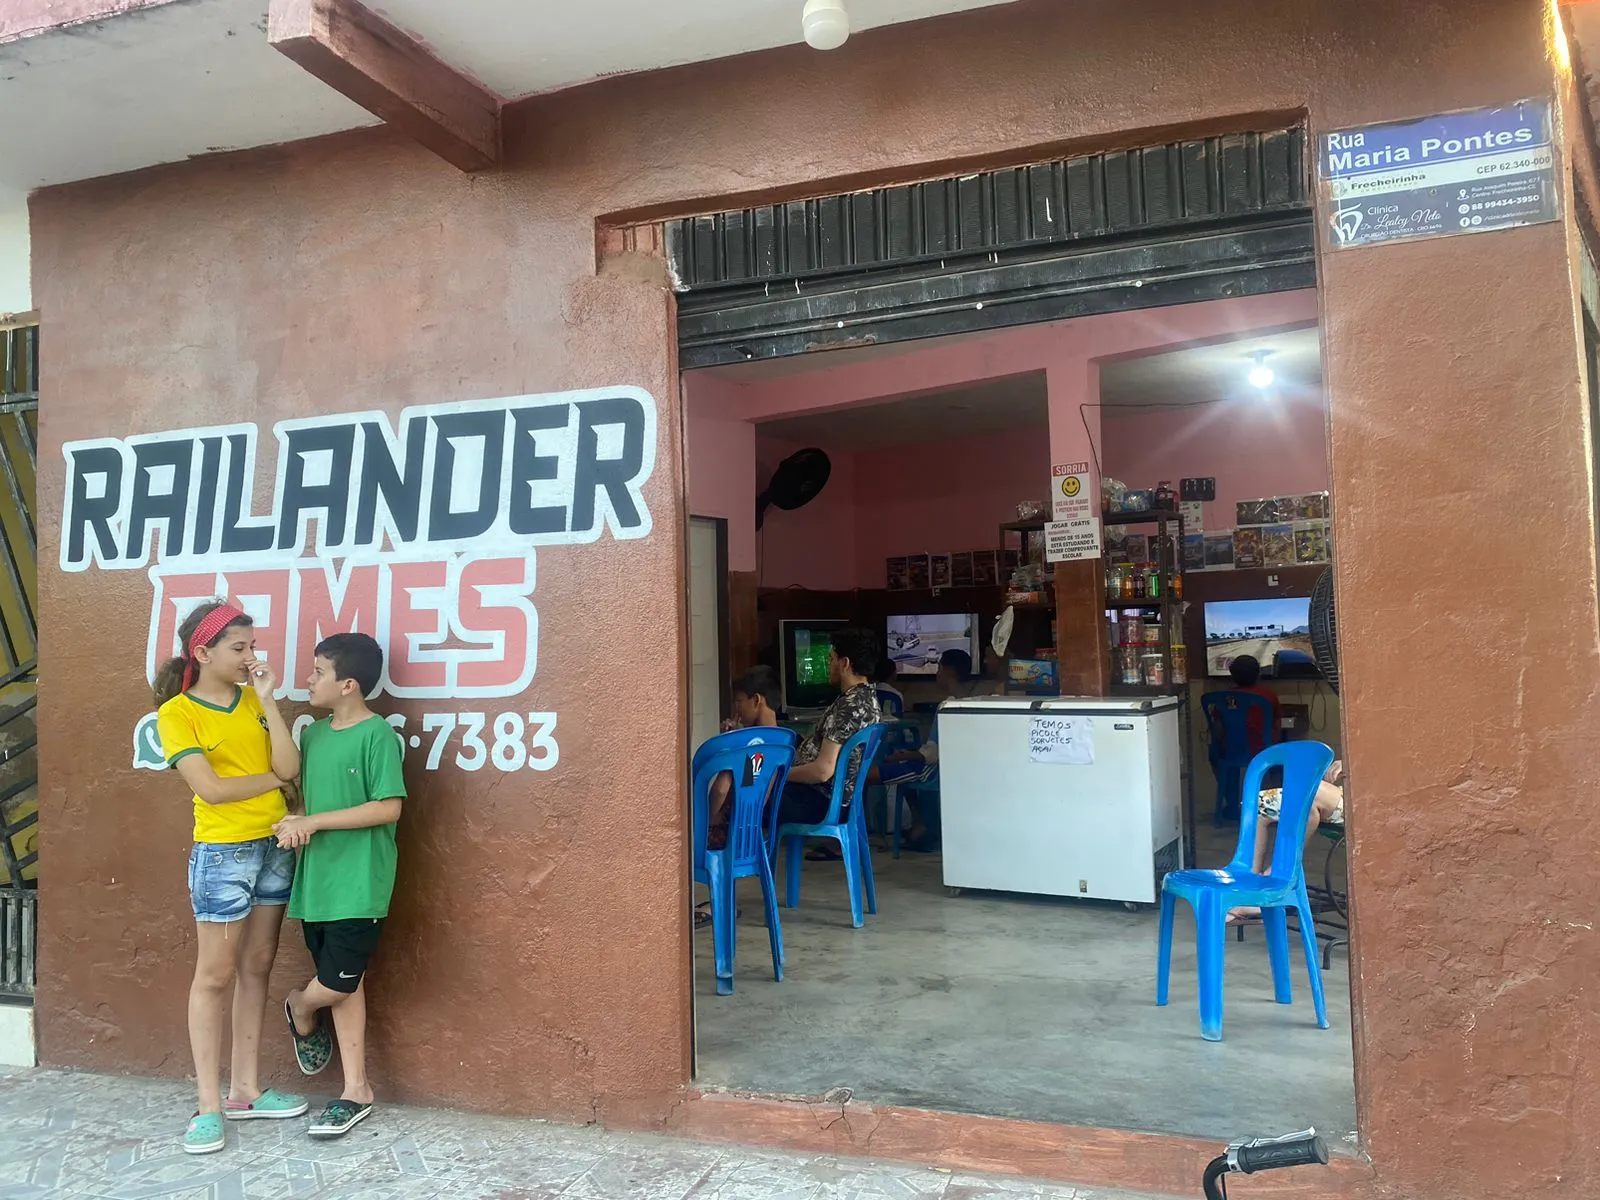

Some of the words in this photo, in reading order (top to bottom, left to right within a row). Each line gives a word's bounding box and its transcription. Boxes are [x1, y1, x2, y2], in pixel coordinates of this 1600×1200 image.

[1327, 132, 1365, 151] Rua
[1328, 146, 1411, 172] Maria
[1421, 127, 1533, 157] Pontes
[1476, 165, 1497, 175] CEP
[1499, 156, 1550, 171] 62.340-000
[1351, 174, 1426, 190] Frecheirinha
[1471, 202, 1483, 211] 88
[1485, 194, 1540, 208] 99434-3950
[1055, 463, 1087, 475] SORRIA
[67, 395, 648, 564] RAILANDER
[1064, 544, 1099, 553] COMPROVANTE
[1034, 719, 1071, 730] TEMOS
[1030, 736, 1072, 745] SORVETES
